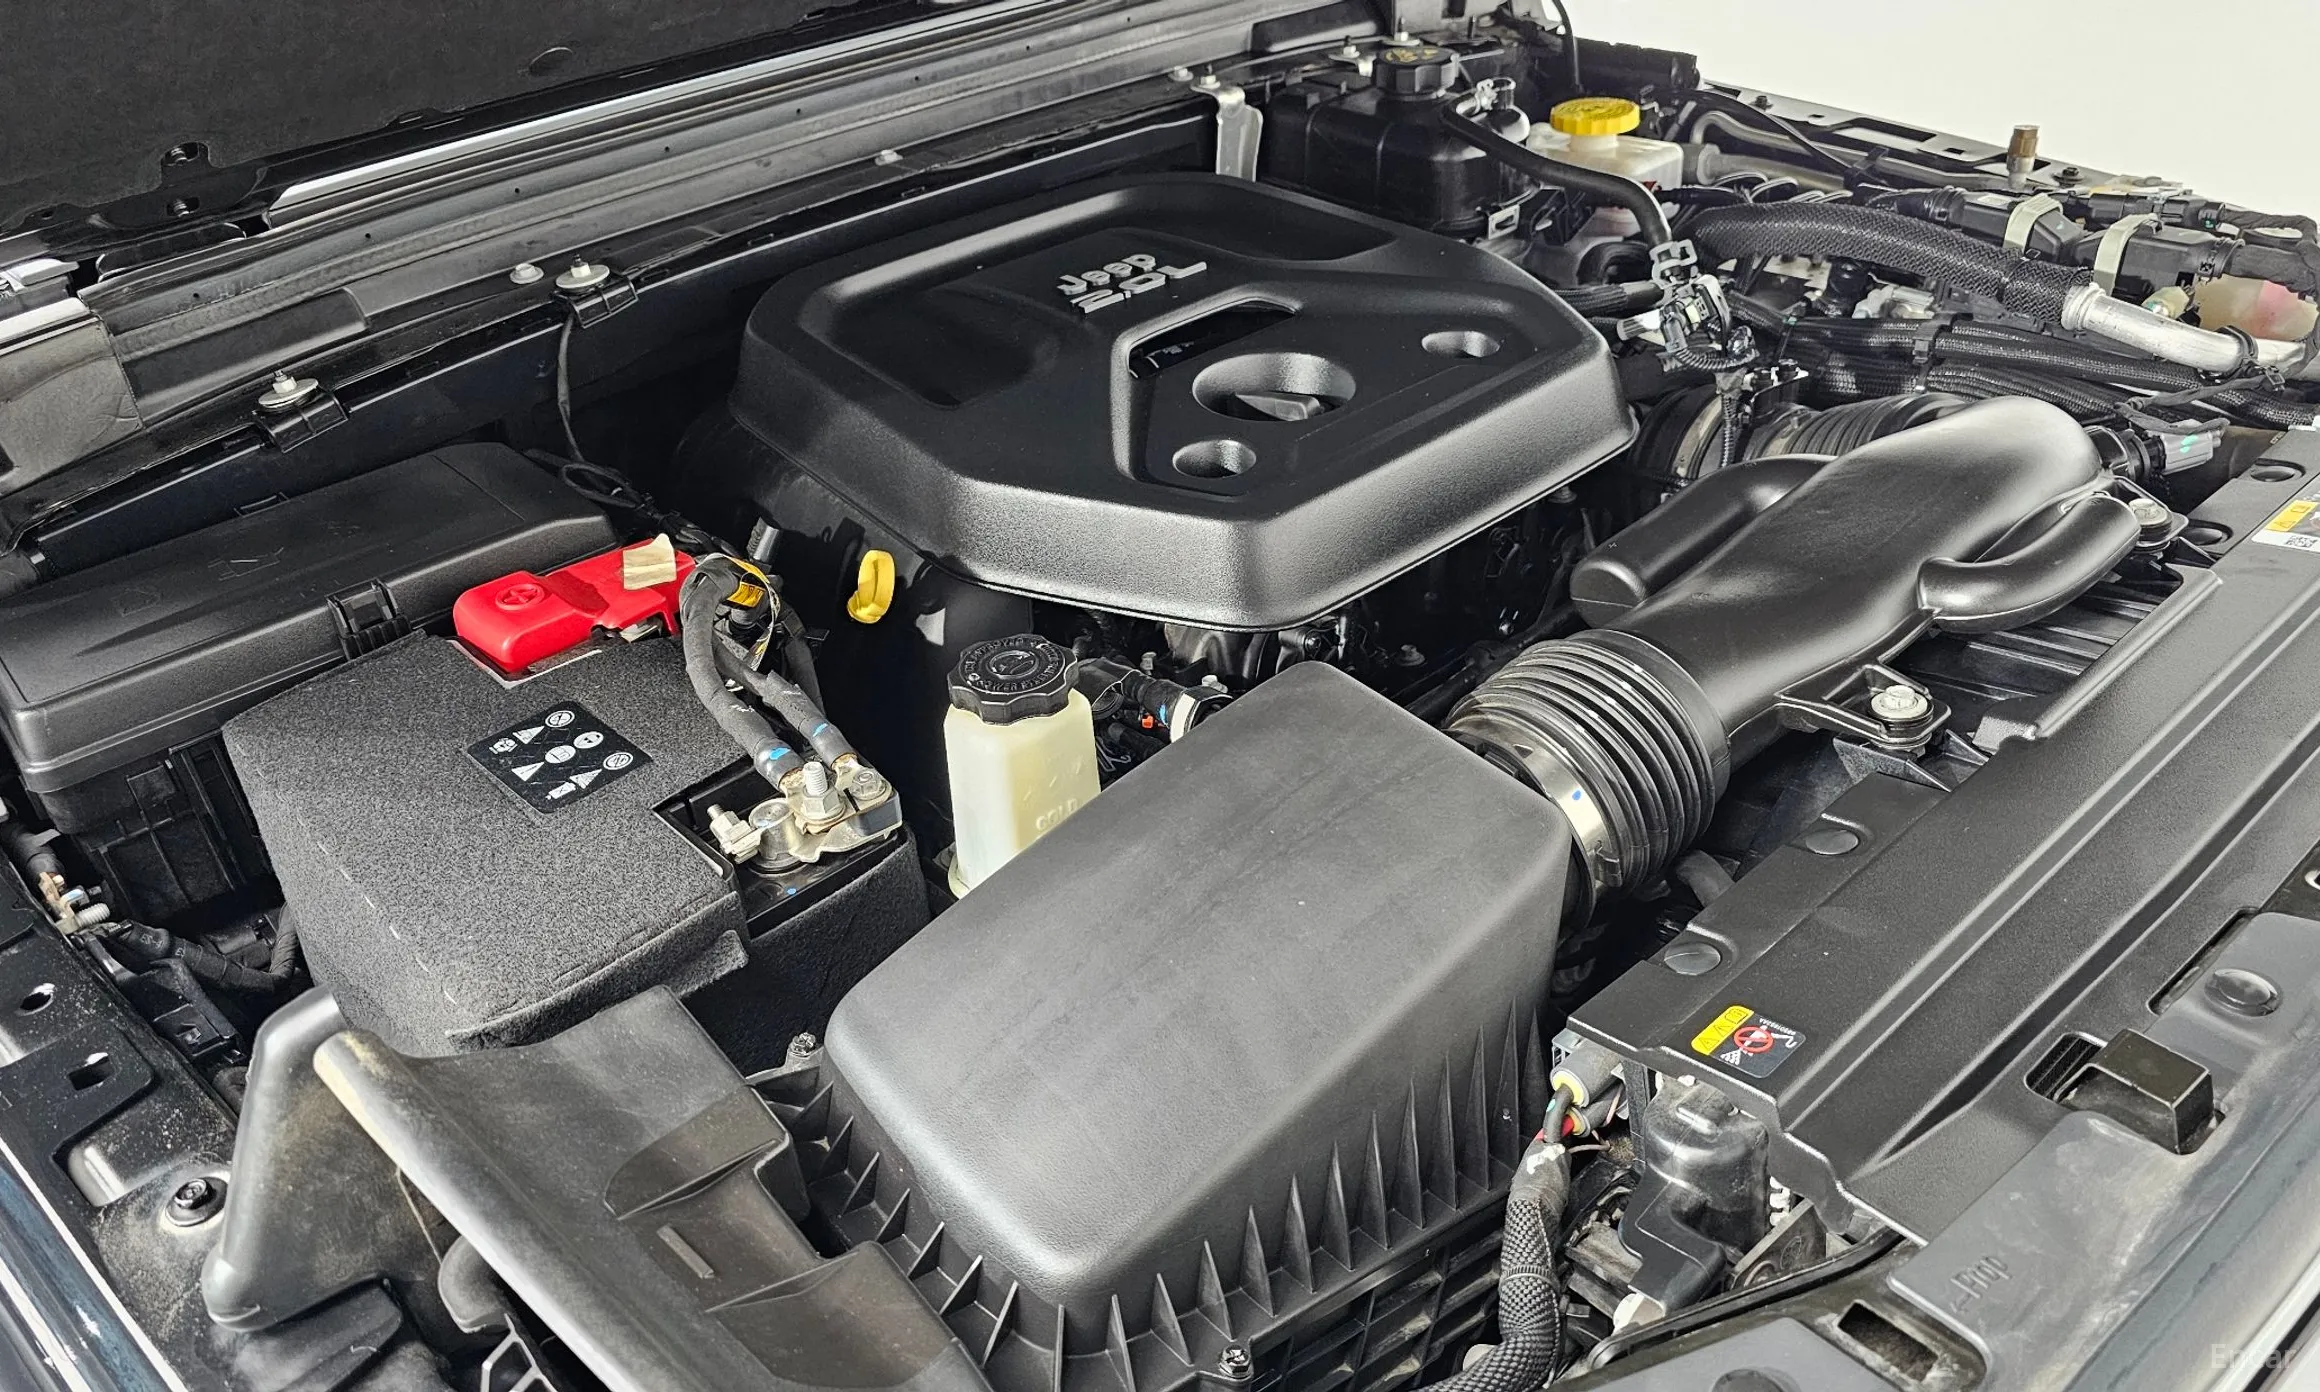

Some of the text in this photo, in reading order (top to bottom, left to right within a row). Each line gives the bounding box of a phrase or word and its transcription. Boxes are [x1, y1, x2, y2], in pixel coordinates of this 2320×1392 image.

[1057, 253, 1156, 295] Jeep
[1070, 261, 1207, 313] 2.0L
[1036, 798, 1078, 831] COLD
